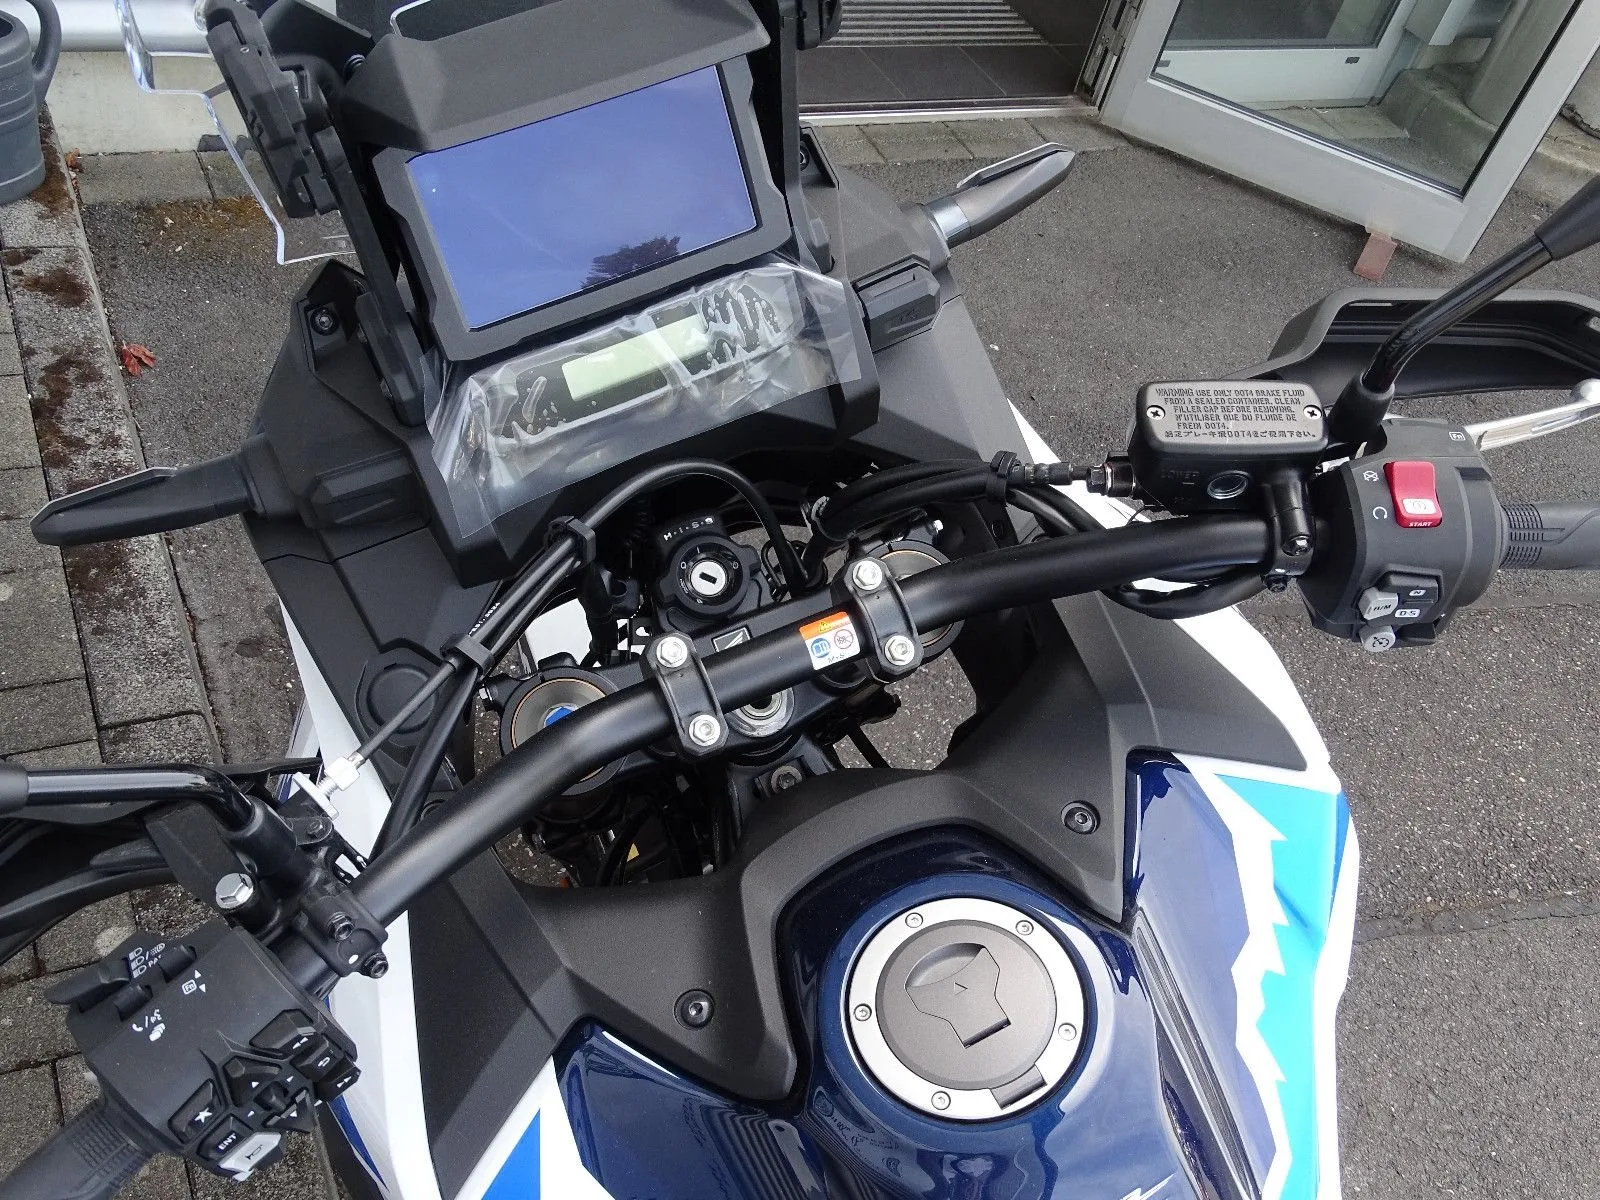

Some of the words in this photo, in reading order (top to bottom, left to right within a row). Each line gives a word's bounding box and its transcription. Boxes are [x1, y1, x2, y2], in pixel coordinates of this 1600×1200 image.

[1155, 388, 1194, 397] WARNING
[1196, 389, 1212, 397] USE
[1213, 389, 1232, 397] ONLY
[1234, 389, 1254, 397] DOT4
[1255, 389, 1281, 397] BRAKE
[1282, 389, 1305, 397] FLUID
[1164, 397, 1186, 405] FROM
[1188, 397, 1193, 405] A
[1194, 397, 1226, 405] SEALED
[1227, 397, 1273, 405] CONTAINER.
[1274, 397, 1301, 405] CLEAN
[1173, 405, 1202, 413] FILLER
[1203, 405, 1219, 413] CAP
[1220, 405, 1252, 413] BEFORE
[1252, 405, 1295, 413] REMOVING.
[1175, 413, 1221, 421] N'UTILISER
[1223, 413, 1240, 421] QUE
[1241, 413, 1253, 421] DU
[1255, 413, 1283, 421] FLUIDE
[1285, 413, 1297, 421] DE
[1177, 422, 1202, 430] FREIN
[1204, 422, 1230, 430] DOT4.
[218, 1132, 237, 1150] ENT
